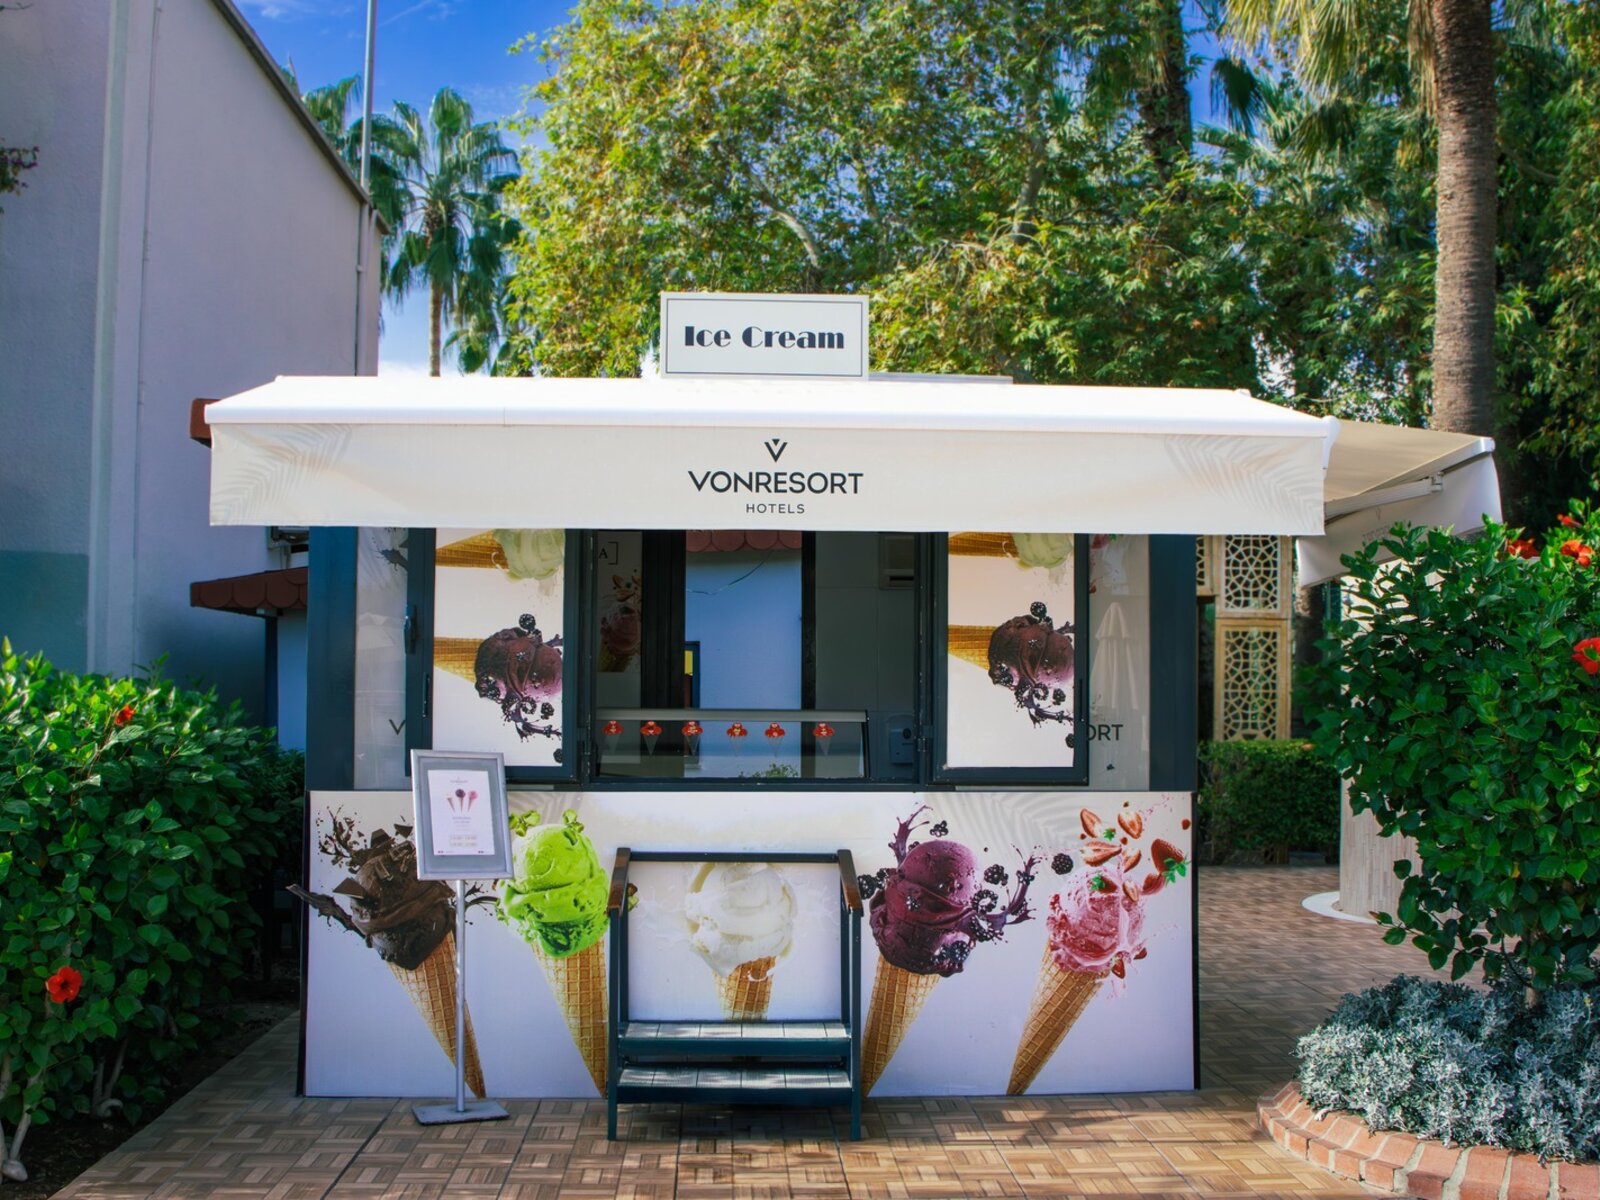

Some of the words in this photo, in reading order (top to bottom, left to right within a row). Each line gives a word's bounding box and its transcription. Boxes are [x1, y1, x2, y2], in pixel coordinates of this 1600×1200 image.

[684, 325, 732, 348] Ice
[741, 326, 845, 349] Cream
[687, 470, 864, 494] VONRESORT
[745, 503, 806, 515] HOTELS
